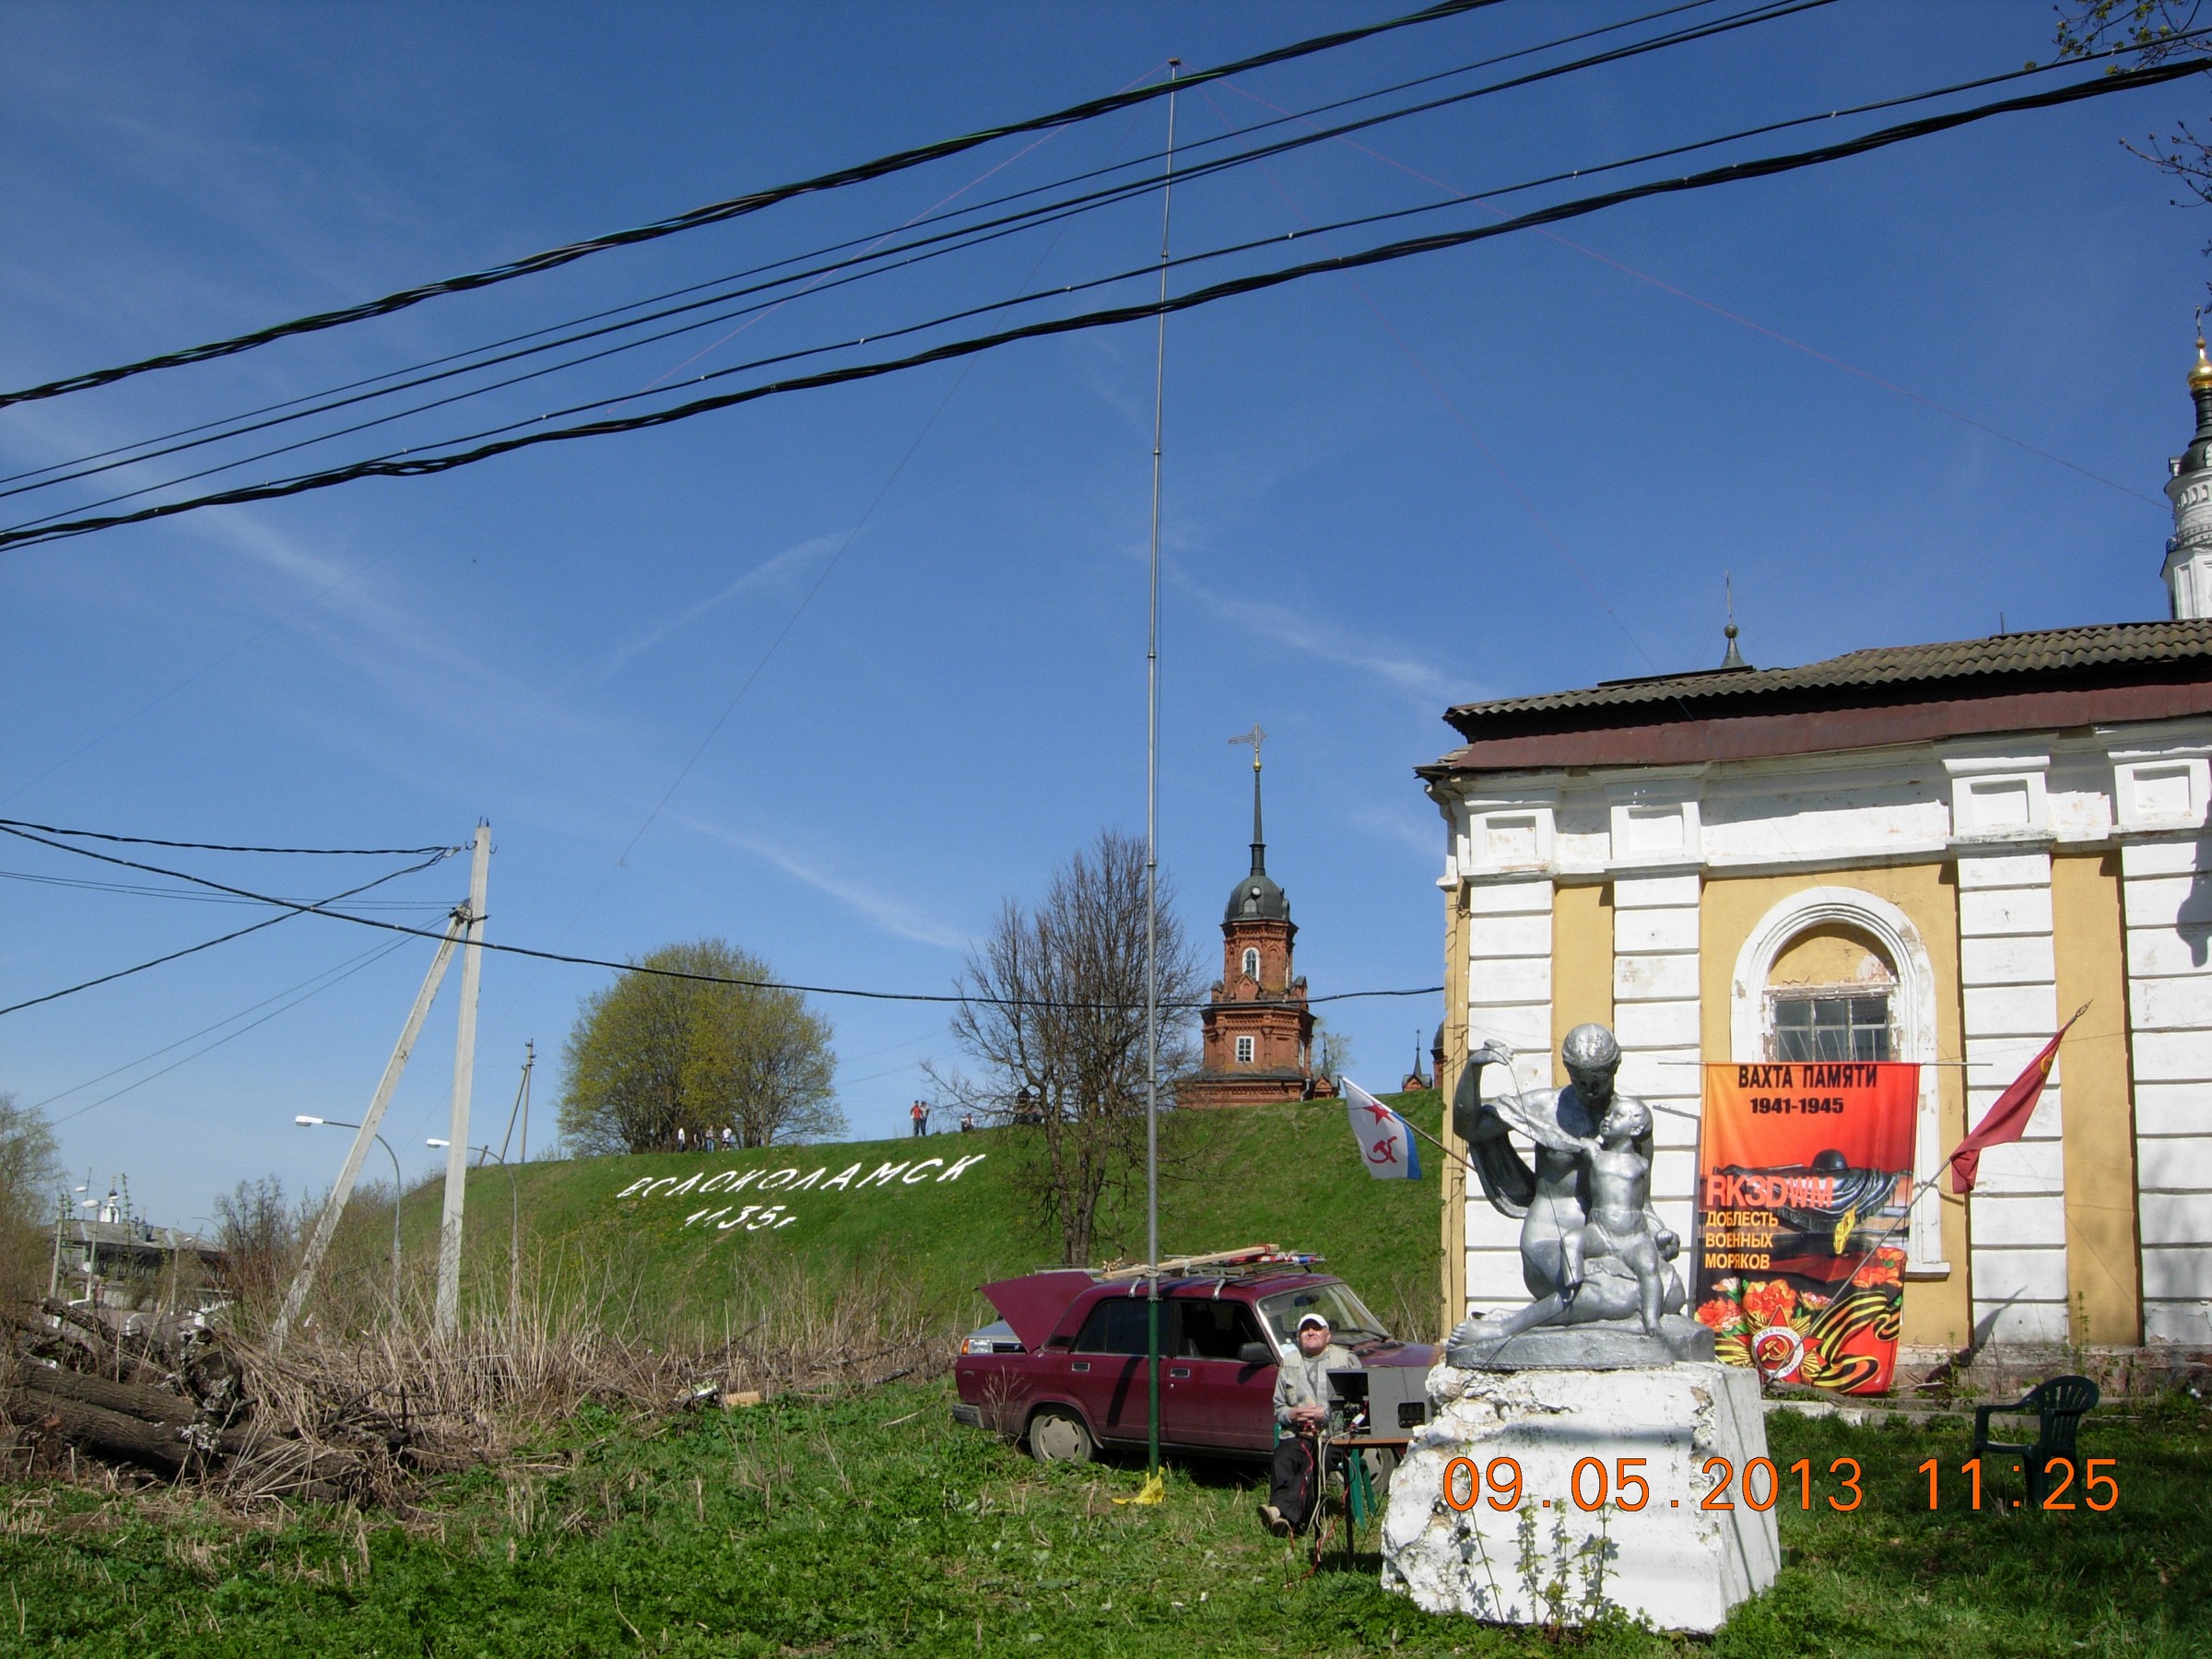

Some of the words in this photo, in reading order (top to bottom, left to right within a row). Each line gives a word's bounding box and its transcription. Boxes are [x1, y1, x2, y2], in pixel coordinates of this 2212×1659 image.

[1738, 1065, 1793, 1088] ВАХТА
[1803, 1065, 1877, 1088] ПАМЯТИ
[1750, 1098, 1844, 1114] 1941-1945
[1706, 1174, 1834, 1208] RK3DWM
[1705, 1211, 1779, 1228] ДОБЛЕСТЬ
[1705, 1232, 1773, 1248] ВОЕННЫХ
[1704, 1253, 1770, 1269] МОРЯКОВ
